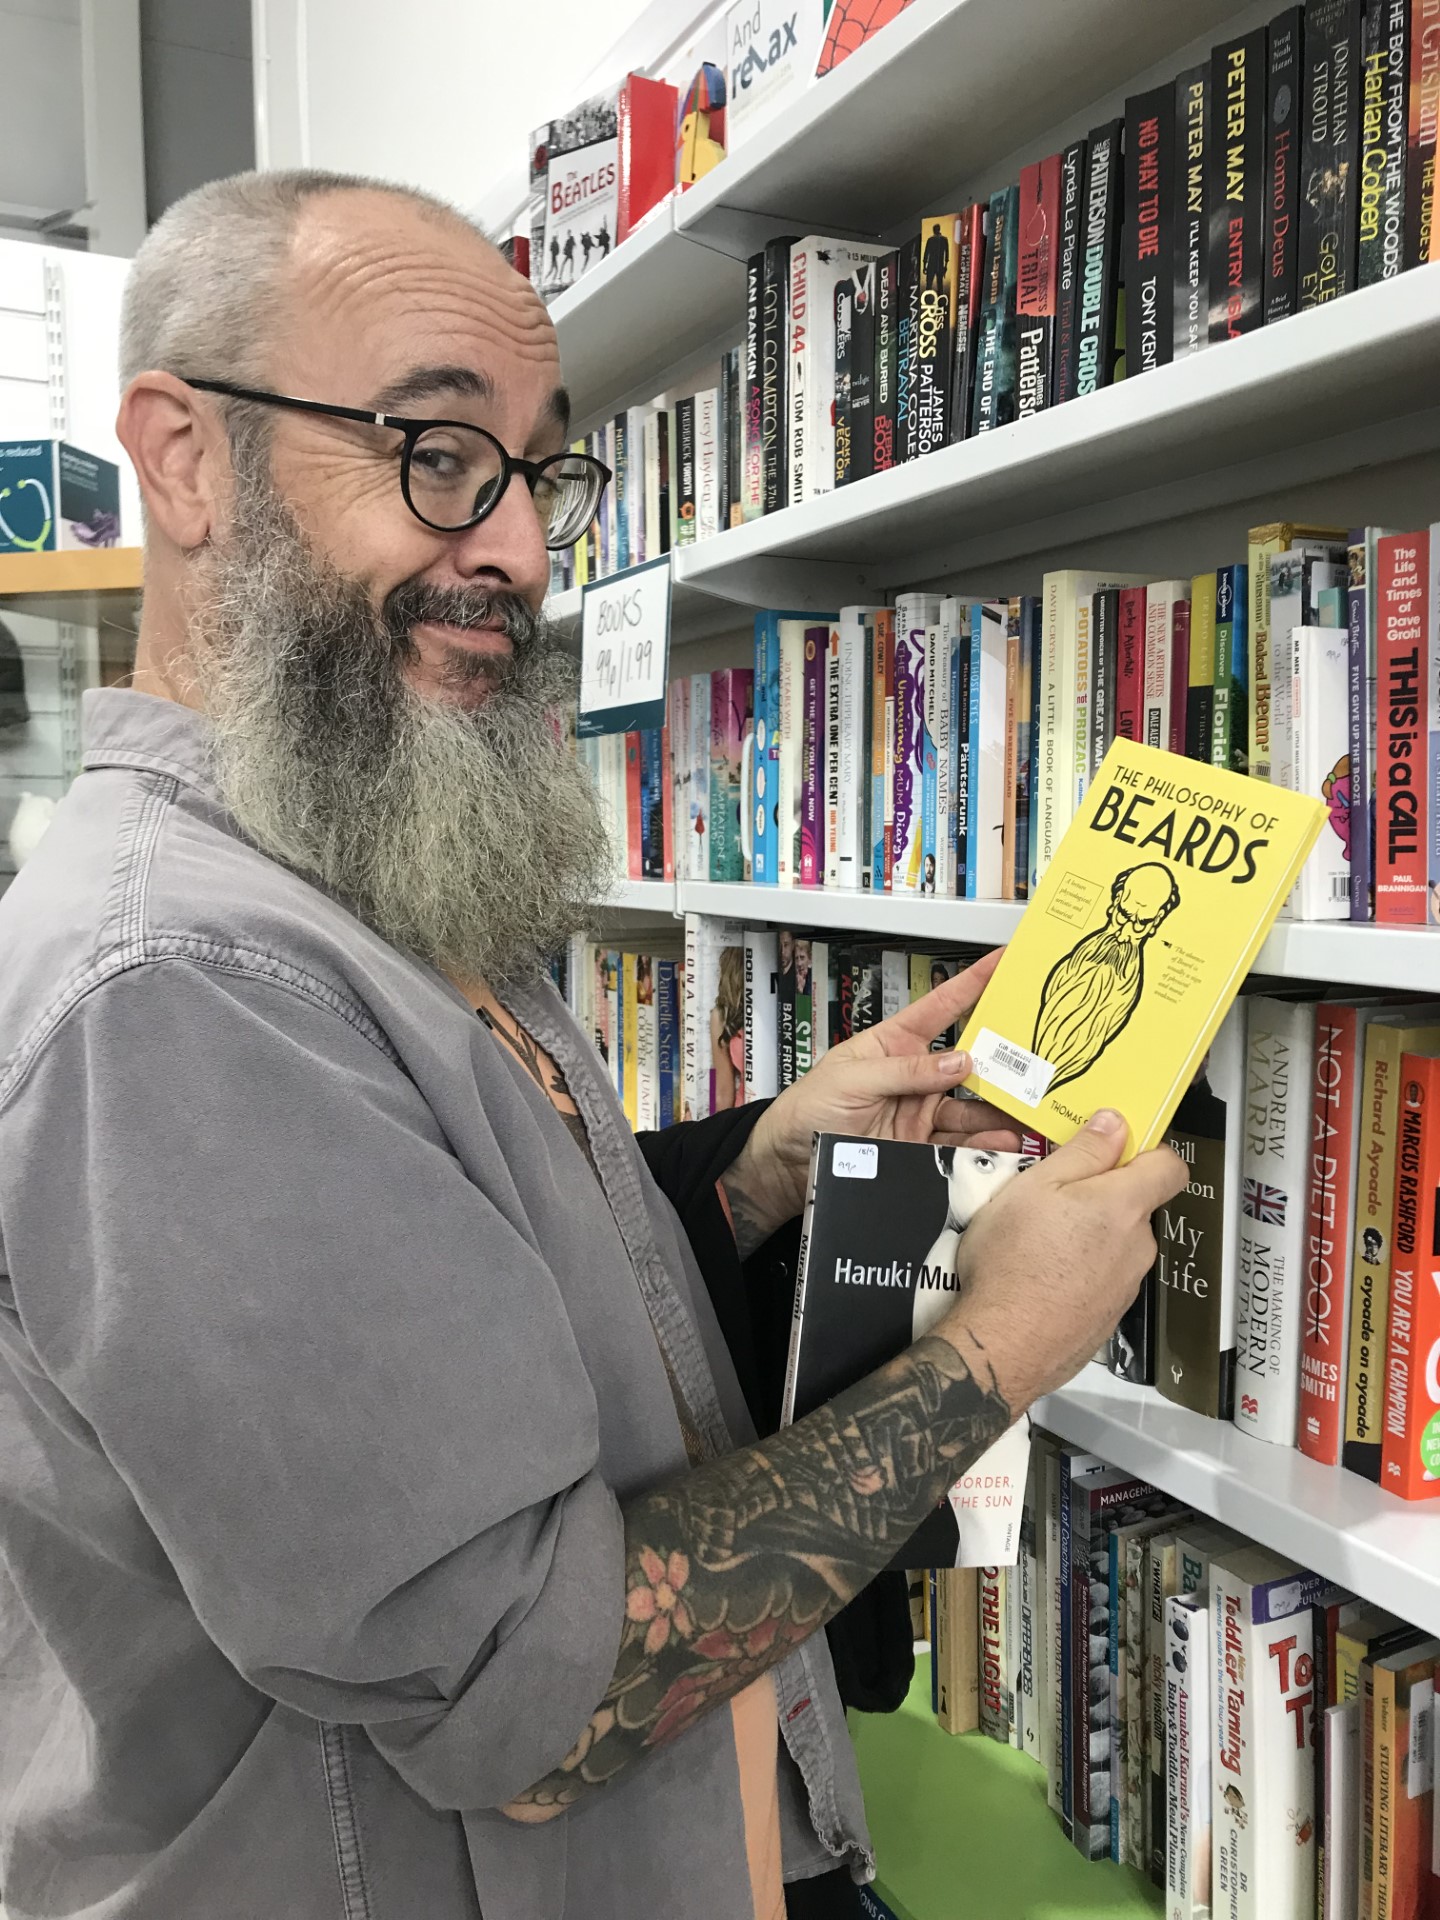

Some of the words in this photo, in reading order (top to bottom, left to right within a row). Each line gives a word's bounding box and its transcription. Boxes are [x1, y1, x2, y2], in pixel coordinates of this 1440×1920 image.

[1272, 57, 1293, 74] Harari
[1273, 31, 1291, 48] Yuval
[1273, 45, 1291, 60] Noah
[1388, 32, 1404, 77] BOY
[1227, 48, 1246, 141] PETER
[1312, 61, 1328, 143] STROUD
[1332, 38, 1349, 147] JONATHAN
[1363, 51, 1388, 146] Harlan
[1419, 26, 1440, 147] Grisham
[1138, 117, 1159, 148] NO
[1188, 80, 1204, 163] PETER
[1387, 82, 1403, 145] FROM
[551, 162, 615, 214] BEATLES
[1066, 149, 1079, 203] Lynda
[1138, 148, 1159, 192] WAY
[1187, 165, 1203, 213] MAY
[1226, 144, 1245, 202] MAY
[1274, 130, 1291, 212] Homo
[1385, 143, 1402, 190] THE
[1064, 205, 1075, 229] La
[1086, 147, 1111, 247] PATTERSON
[1138, 197, 1159, 224] TO
[1360, 148, 1387, 243] Coben
[1062, 233, 1075, 290] Plante
[1138, 224, 1159, 261] DIE
[1227, 217, 1243, 288] ENTRY
[1272, 215, 1290, 278] Deus
[1383, 198, 1400, 280] WOODS
[749, 267, 758, 303] IAN
[792, 251, 807, 320] CHILD
[1021, 248, 1039, 309] TRIAL
[1081, 244, 1104, 333] DOUBLE
[1141, 277, 1157, 330] TONY
[747, 306, 757, 380] RANKIN
[792, 325, 805, 354] 44
[908, 284, 918, 383] MARTINA
[919, 290, 937, 359] CROSS
[898, 318, 909, 427] BETRAYAL
[1141, 332, 1157, 372] KENT
[795, 391, 804, 423] TOM
[907, 392, 917, 455] COLE
[932, 387, 943, 442] JAMES
[794, 427, 803, 459] ROB
[1392, 573, 1417, 587] and
[1394, 548, 1416, 560] The
[1395, 561, 1415, 574] Life
[597, 589, 642, 636] BOOKS
[1158, 602, 1166, 619] THE
[1386, 588, 1422, 601] Times
[1398, 601, 1412, 613] of
[1157, 623, 1165, 644] NEW
[1387, 626, 1421, 641] Grohl
[1388, 615, 1420, 628] Dave
[830, 658, 839, 682] THE
[896, 646, 905, 675] THE
[1076, 607, 1089, 692] POTATOES
[1156, 648, 1165, 698] ARTHRITIS
[1255, 631, 1268, 681] Baked
[829, 684, 839, 721] EXTRA
[928, 669, 936, 724] MITCHELL
[1077, 694, 1087, 704] not
[1389, 647, 1418, 729] THIS
[895, 679, 907, 763] Unmumsy
[940, 709, 948, 753] BABY
[1075, 706, 1087, 774] PROZAC
[1255, 684, 1271, 752] Beans
[1389, 731, 1417, 759] is
[829, 777, 838, 806] CENT
[895, 769, 904, 805] MUM
[939, 759, 947, 814] NAMES
[959, 743, 969, 836] Päntsdrunk
[1113, 765, 1139, 789] THE
[1144, 779, 1246, 823] PHILOSOPHY
[1251, 812, 1279, 833] OF
[1388, 763, 1412, 790] a
[892, 811, 906, 855] Diary
[1044, 797, 1052, 861] LANGUAGE
[1089, 785, 1269, 885] BEARDS
[1388, 790, 1418, 865] CALL
[1377, 883, 1427, 894] BRANNIGAN
[1392, 875, 1413, 884] PAUL
[686, 929, 695, 1000] LEONA
[659, 966, 672, 1029] Danielle
[782, 1003, 792, 1040] BACK
[660, 1033, 672, 1074] Steel
[686, 1013, 695, 1083] LEWIS
[745, 988, 753, 1083] MORTIMER
[782, 1045, 792, 1085] FROM
[974, 1057, 989, 1075] 99p
[1316, 1025, 1343, 1108] NOT
[1050, 1099, 1083, 1125] THOMAS
[1246, 1029, 1273, 1158] MARR
[1269, 1040, 1290, 1161] ANDREW
[1372, 1060, 1388, 1136] Richard
[1314, 1114, 1339, 1141] A
[1402, 1110, 1421, 1173] MARCUS
[1311, 1155, 1337, 1230] DIET
[1367, 1141, 1384, 1216] Ayoade
[1164, 1210, 1203, 1258] My
[1397, 1175, 1419, 1255] RASHFORD
[794, 1234, 809, 1321] Murakami
[834, 1257, 912, 1289] Haruki
[1159, 1254, 1209, 1299] Life
[1274, 1257, 1285, 1282] THE
[1306, 1236, 1333, 1346] BOOK
[1394, 1269, 1413, 1308] YOU
[1236, 1239, 1252, 1372] BRITAIN
[1248, 1242, 1272, 1380] MODERN
[1271, 1287, 1284, 1342] MAKING
[1360, 1275, 1374, 1342] ayoade
[1392, 1310, 1411, 1342] ARE
[1269, 1350, 1281, 1376] OF
[1301, 1353, 1338, 1381] JAMES
[1360, 1347, 1370, 1368] on
[1391, 1346, 1409, 1359] A
[1300, 1374, 1335, 1402] SMITH
[1356, 1373, 1370, 1438] ayoade
[1387, 1358, 1408, 1439] CHAMPION
[953, 1496, 979, 1509] THE
[985, 1495, 1013, 1508] SUN
[1061, 1465, 1070, 1489] The
[1061, 1493, 1070, 1511] Art
[1061, 1515, 1070, 1527] of
[1060, 1530, 1070, 1586] Coaching
[984, 1586, 1000, 1636] THE
[983, 1638, 1002, 1714] LIGHT
[1022, 1607, 1033, 1698] DIFFERENCES
[1153, 1654, 1163, 1691] sticky
[1153, 1692, 1164, 1741] wisdom
[1179, 1687, 1189, 1753] Annabel
[1220, 1690, 1244, 1776] Taming
[1180, 1754, 1189, 1822] Karmel's
[1380, 1745, 1391, 1812] STUDYING
[1219, 1846, 1227, 1892] GREEN
[1379, 1815, 1390, 1878] LITERARY
[1239, 1872, 1247, 1893] DR
